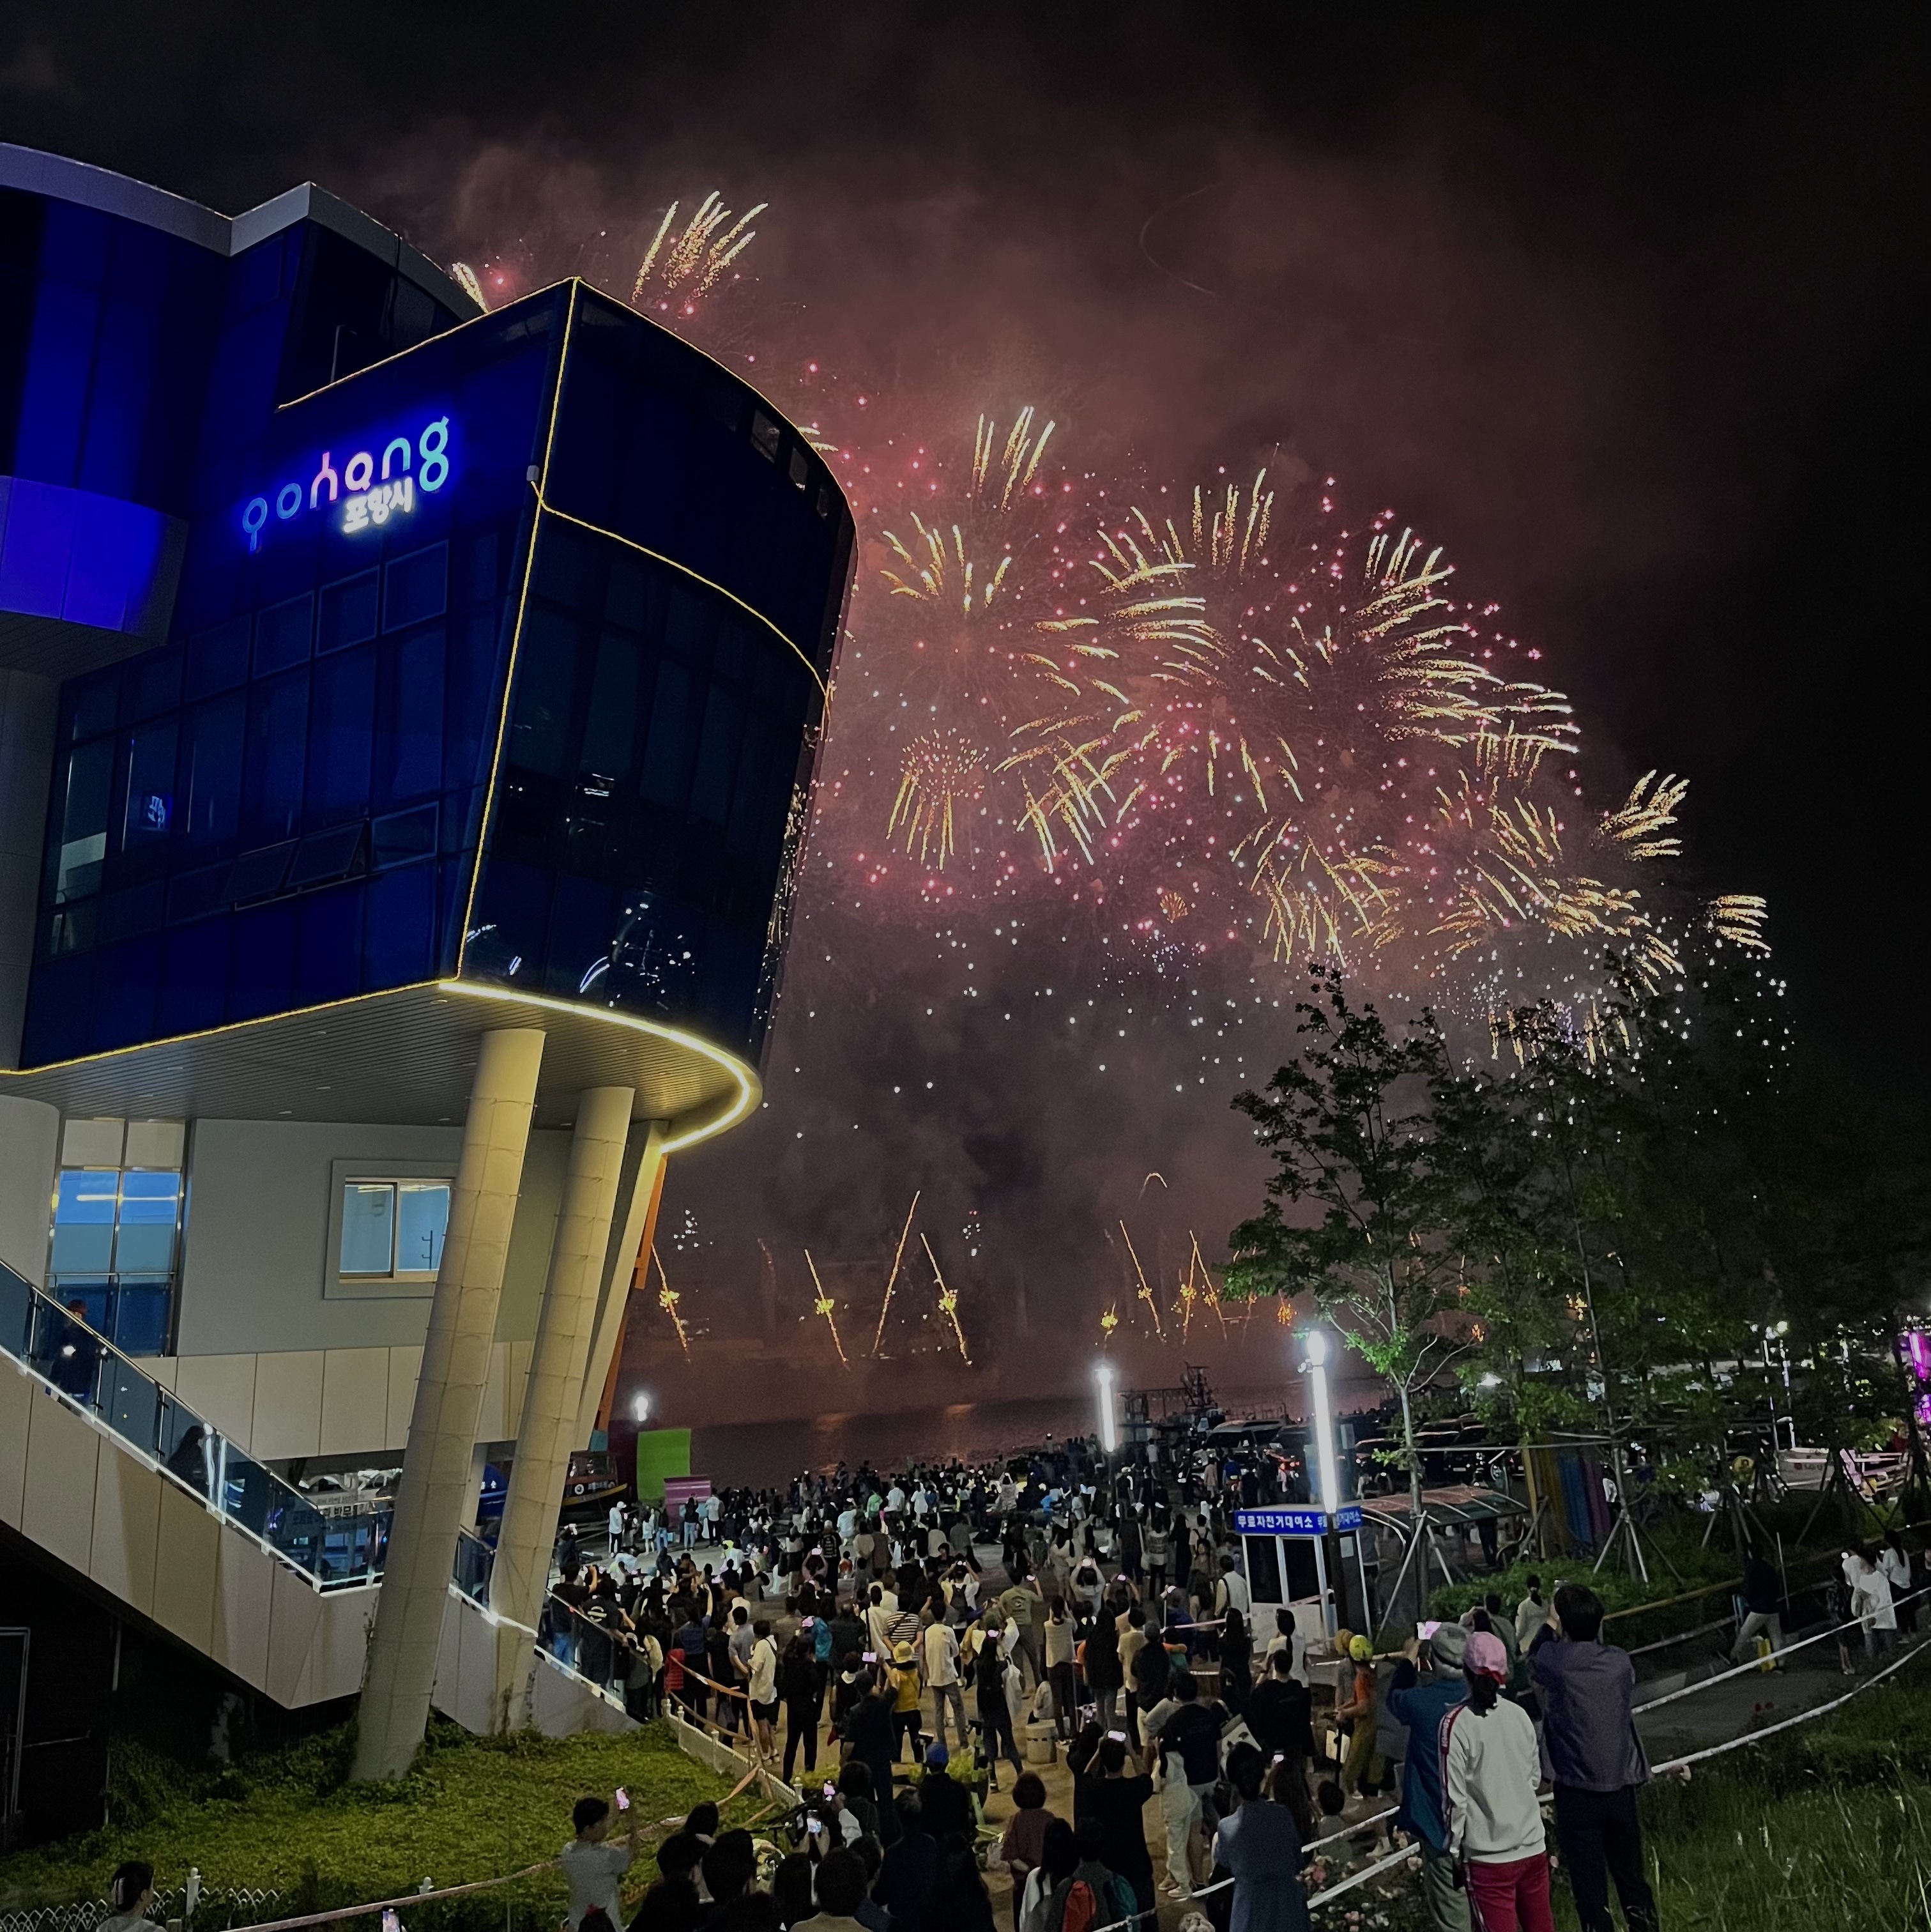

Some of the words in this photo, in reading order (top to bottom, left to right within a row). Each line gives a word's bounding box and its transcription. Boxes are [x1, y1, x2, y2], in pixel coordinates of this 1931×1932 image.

[242, 416, 450, 551] pohang
[342, 476, 413, 534] 포항시
[1237, 1515, 1313, 1529] 무료자전거대여소
